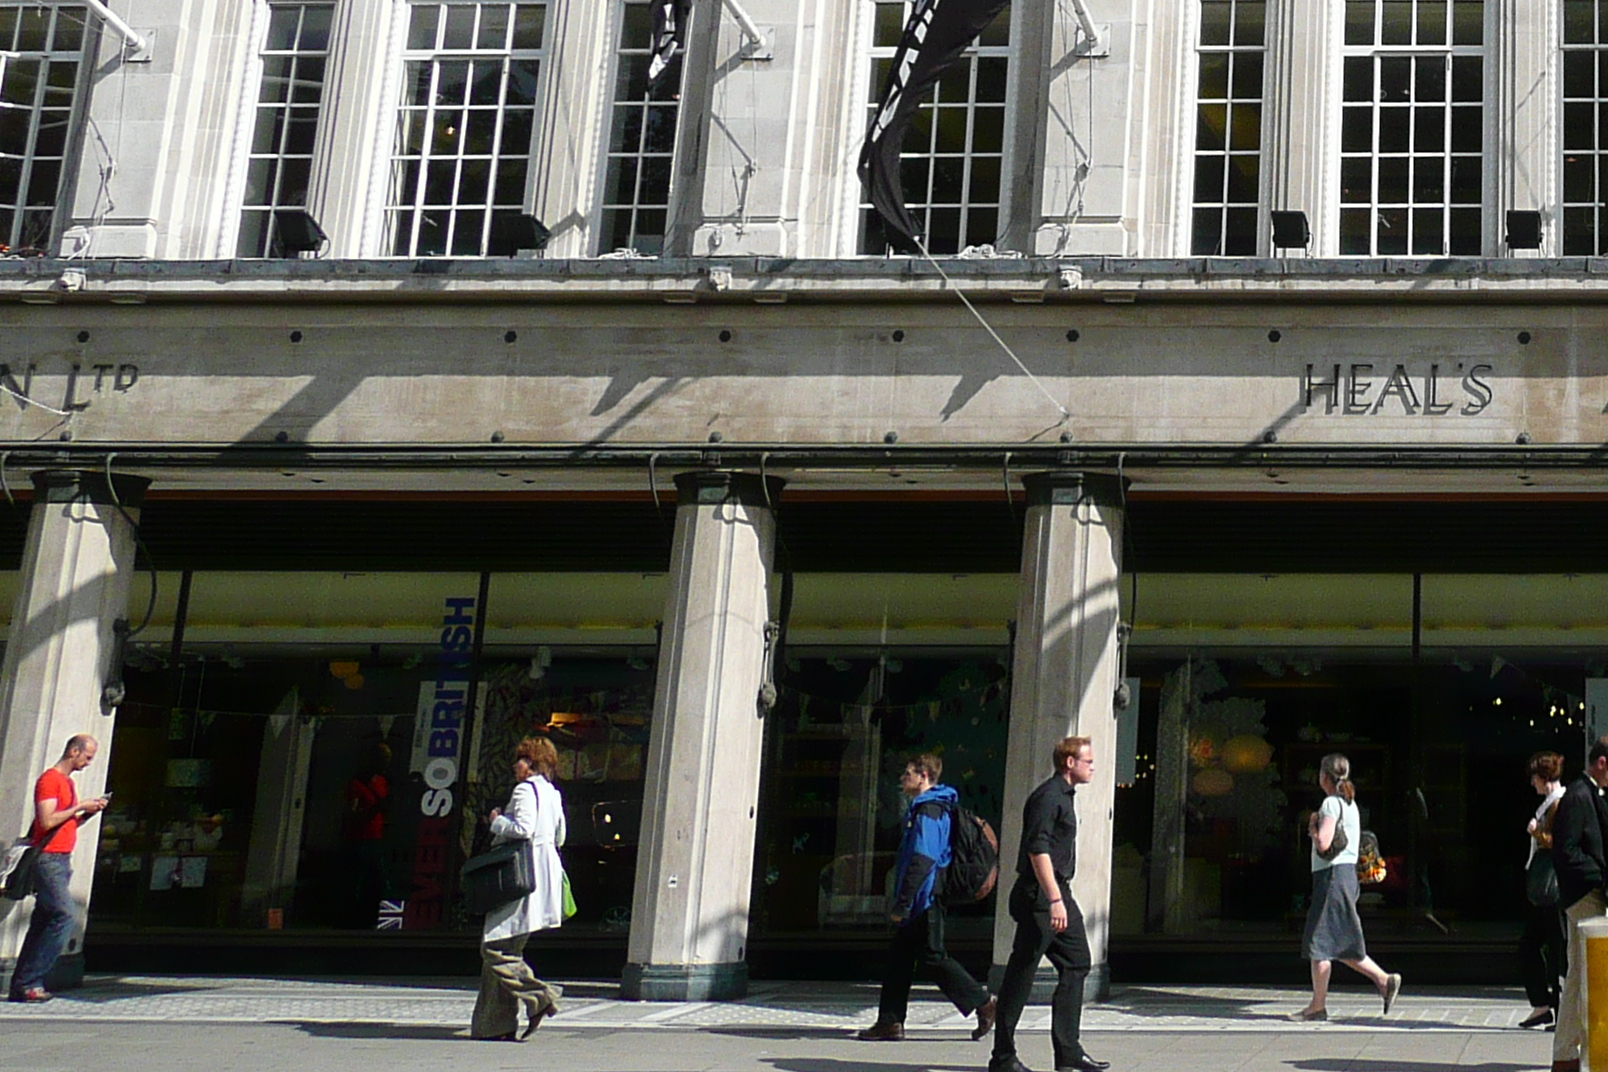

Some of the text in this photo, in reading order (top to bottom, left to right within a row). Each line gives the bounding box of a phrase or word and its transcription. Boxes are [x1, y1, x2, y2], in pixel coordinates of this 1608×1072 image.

[1302, 363, 1494, 413] HEAL'S
[428, 597, 475, 758] BRITISH
[420, 756, 457, 818] SO
